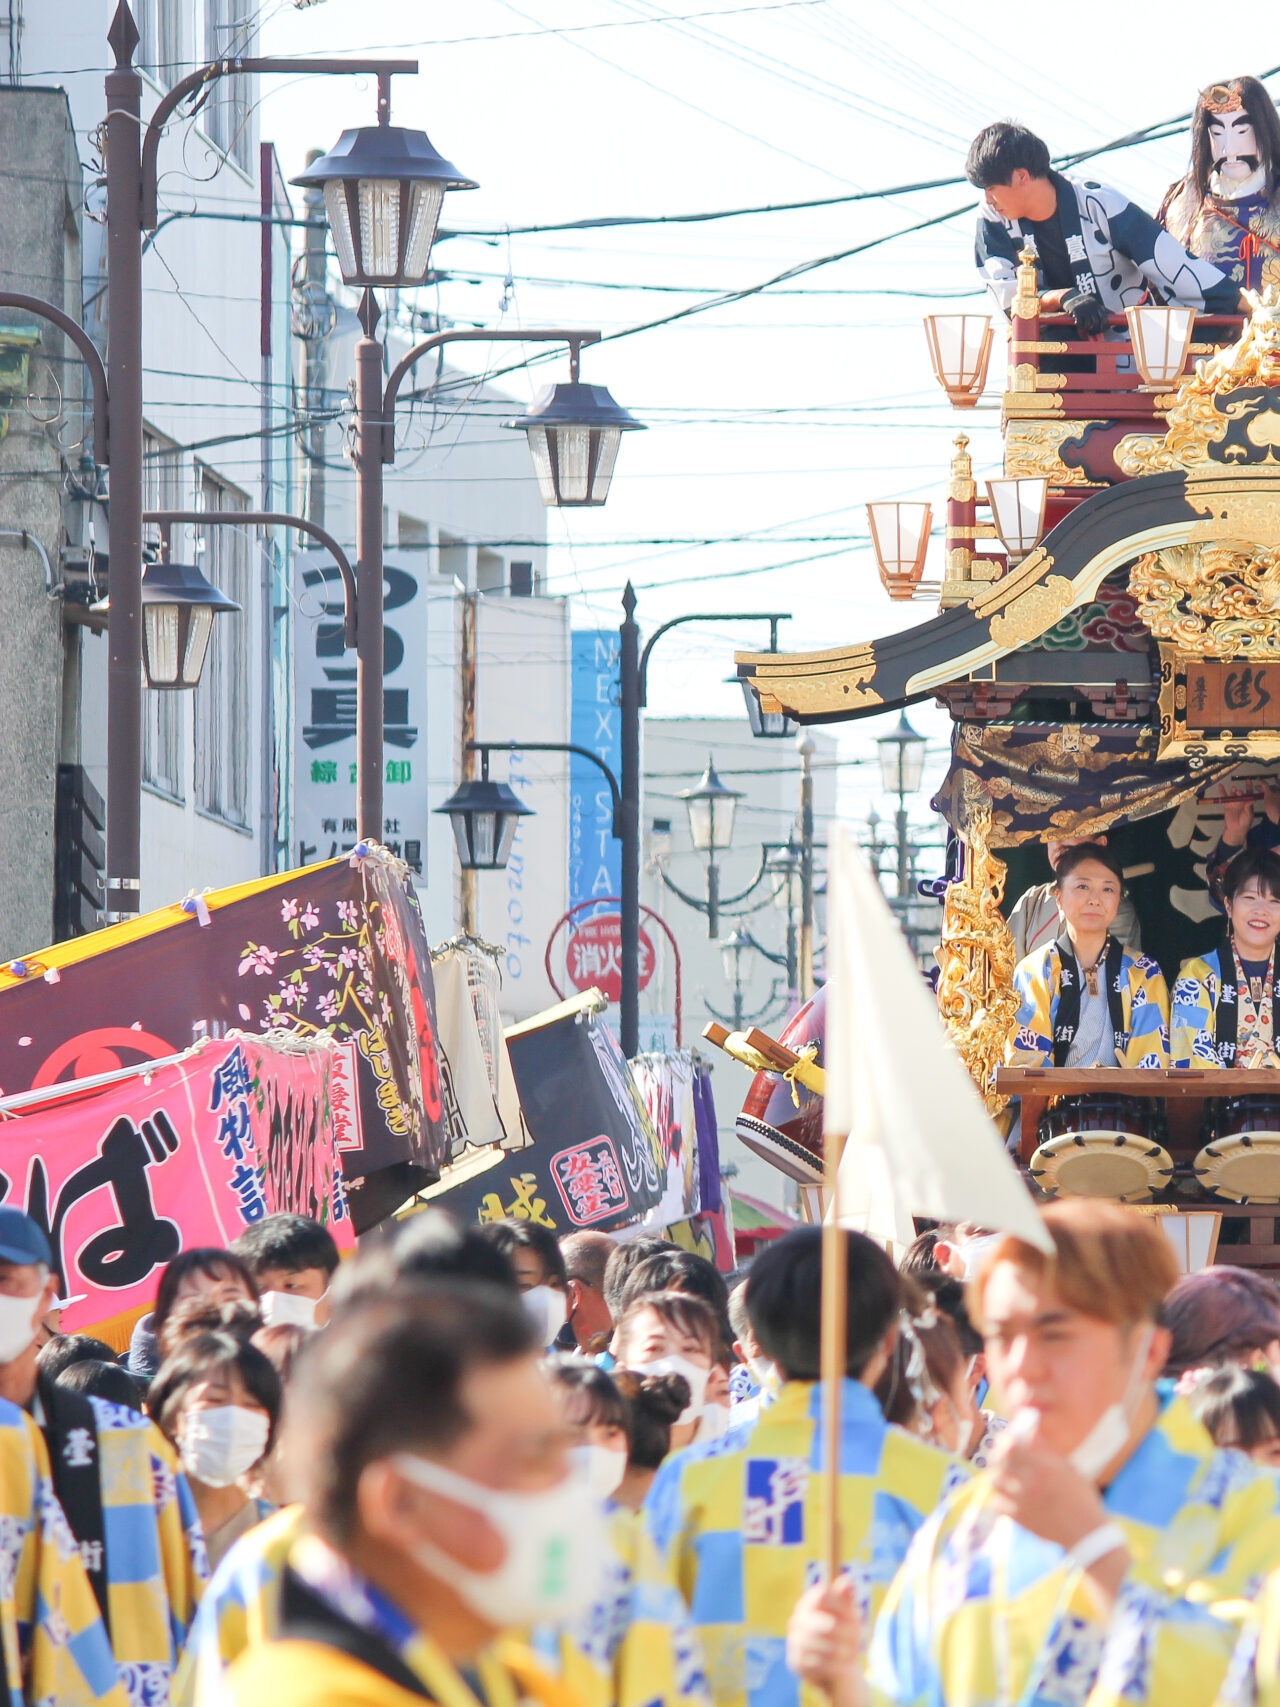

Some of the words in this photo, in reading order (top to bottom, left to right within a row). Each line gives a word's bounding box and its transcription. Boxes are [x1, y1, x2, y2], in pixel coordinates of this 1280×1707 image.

[321, 818, 400, 834] 有限社
[0, 1109, 181, 1300] ば
